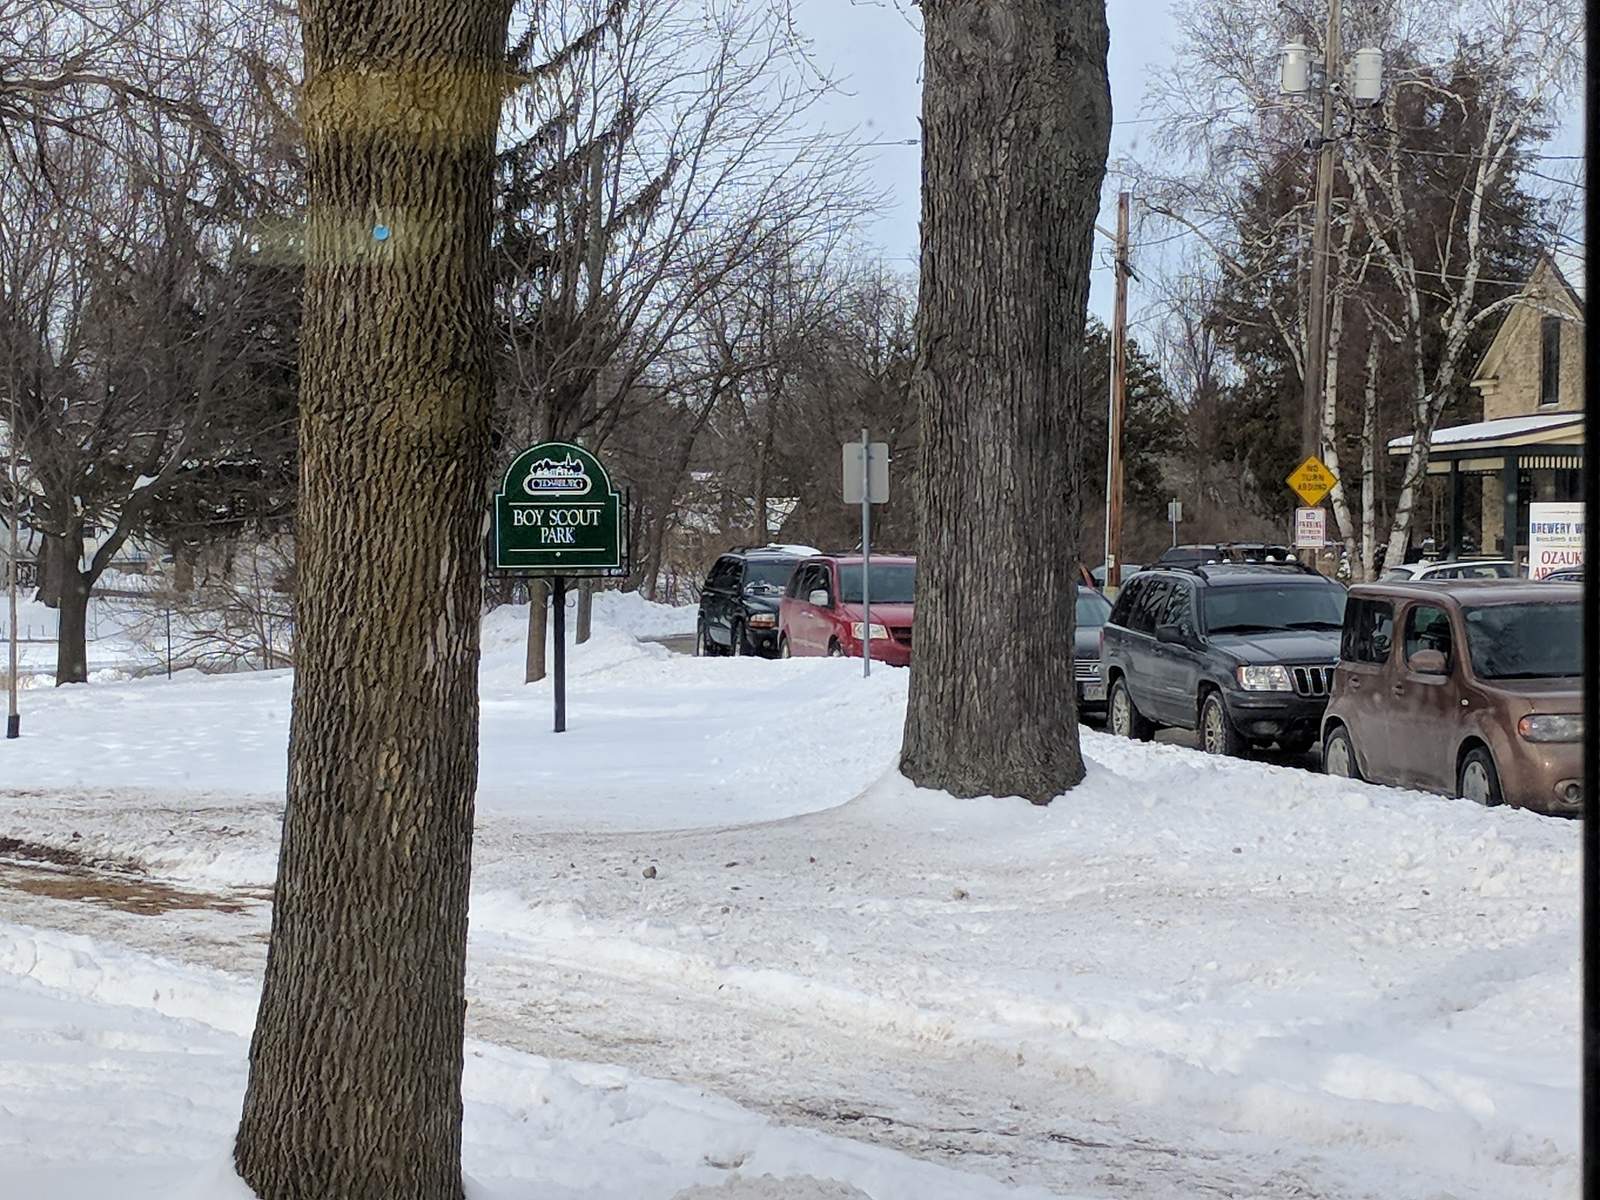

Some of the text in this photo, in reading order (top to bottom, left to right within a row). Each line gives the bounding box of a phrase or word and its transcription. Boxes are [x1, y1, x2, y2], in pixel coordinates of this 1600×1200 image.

[513, 509, 601, 526] BOY SCOUT
[541, 527, 576, 544] PARK
[1531, 522, 1571, 534] BREWERY
[1541, 551, 1583, 565] OZAUK
